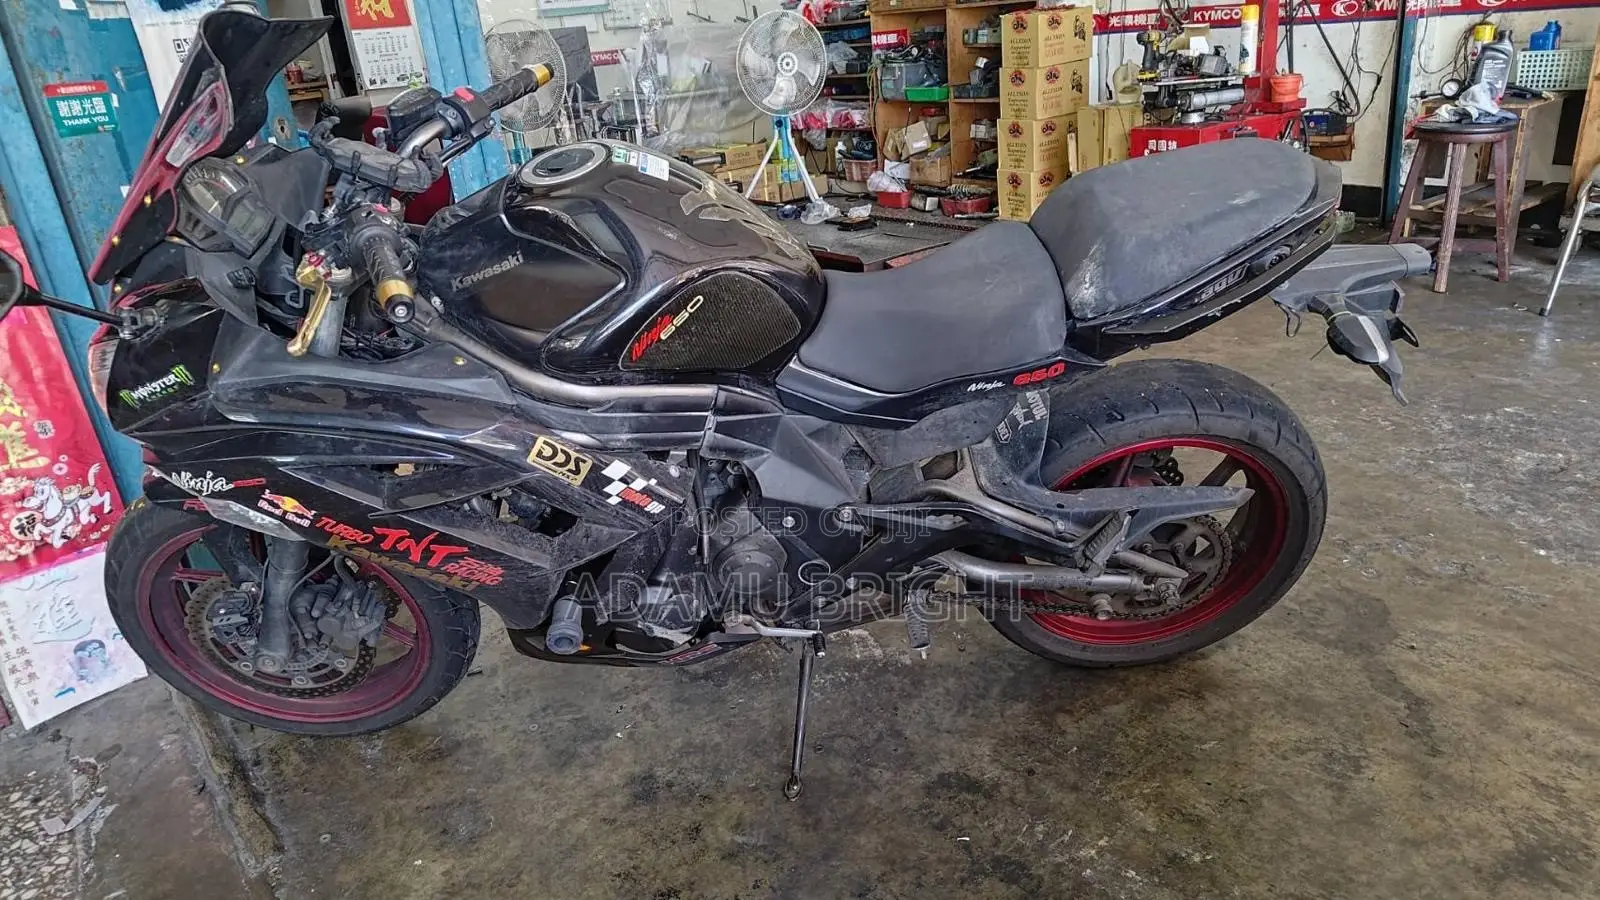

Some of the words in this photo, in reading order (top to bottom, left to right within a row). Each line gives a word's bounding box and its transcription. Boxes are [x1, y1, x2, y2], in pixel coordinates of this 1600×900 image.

[1193, 9, 1242, 22] KYMCO
[56, 97, 106, 117] 謝謝光臨
[62, 117, 92, 126] THANK
[92, 115, 109, 123] YOU
[451, 250, 524, 292] Kawasaki
[660, 295, 704, 341] 650
[131, 374, 181, 400] MONSTER
[967, 380, 1006, 392] Ninja
[1013, 363, 1065, 385] 650
[536, 440, 587, 476] DDS
[171, 471, 235, 496] Ninja
[17, 515, 39, 538] 福
[257, 499, 284, 516] Red
[285, 512, 311, 528] Bull
[315, 516, 374, 544] TURBO
[372, 526, 469, 568] TNT
